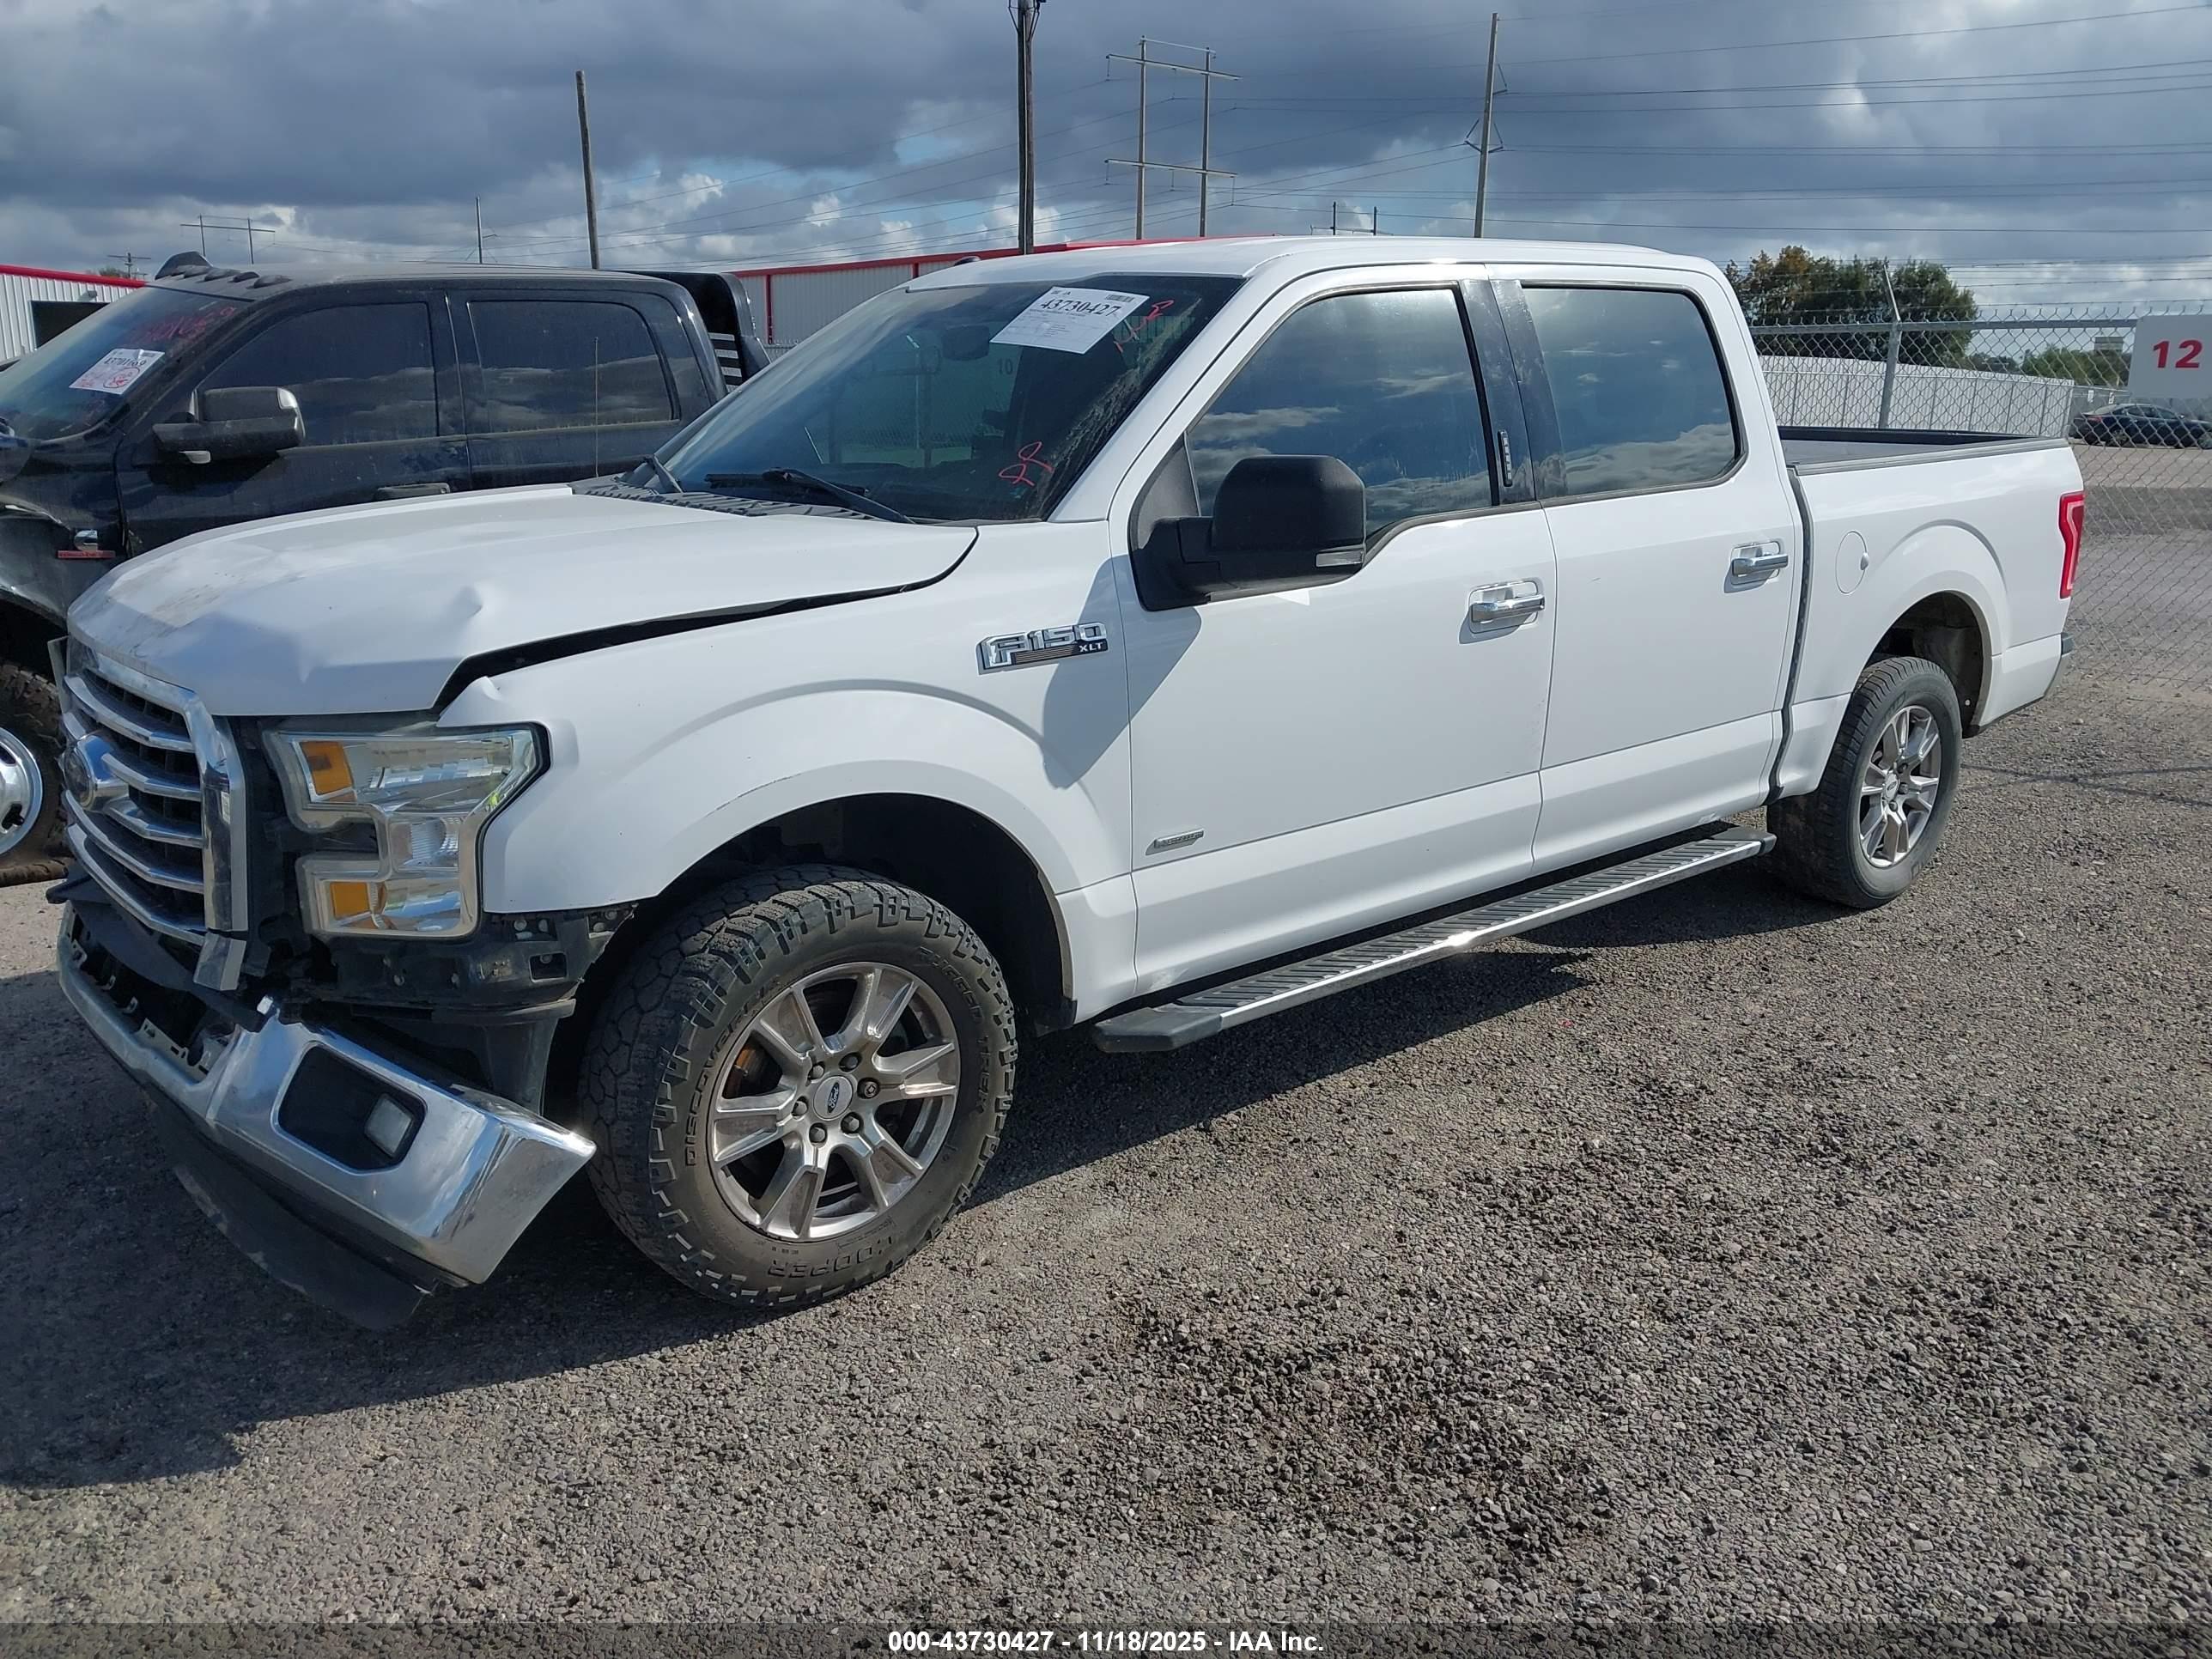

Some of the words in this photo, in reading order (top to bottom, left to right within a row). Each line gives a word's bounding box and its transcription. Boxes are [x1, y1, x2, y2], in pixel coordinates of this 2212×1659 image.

[1040, 298, 1121, 317] 43730427
[2153, 339, 2203, 368] 12
[998, 357, 1013, 374] 10
[1079, 642, 1103, 653] XLT
